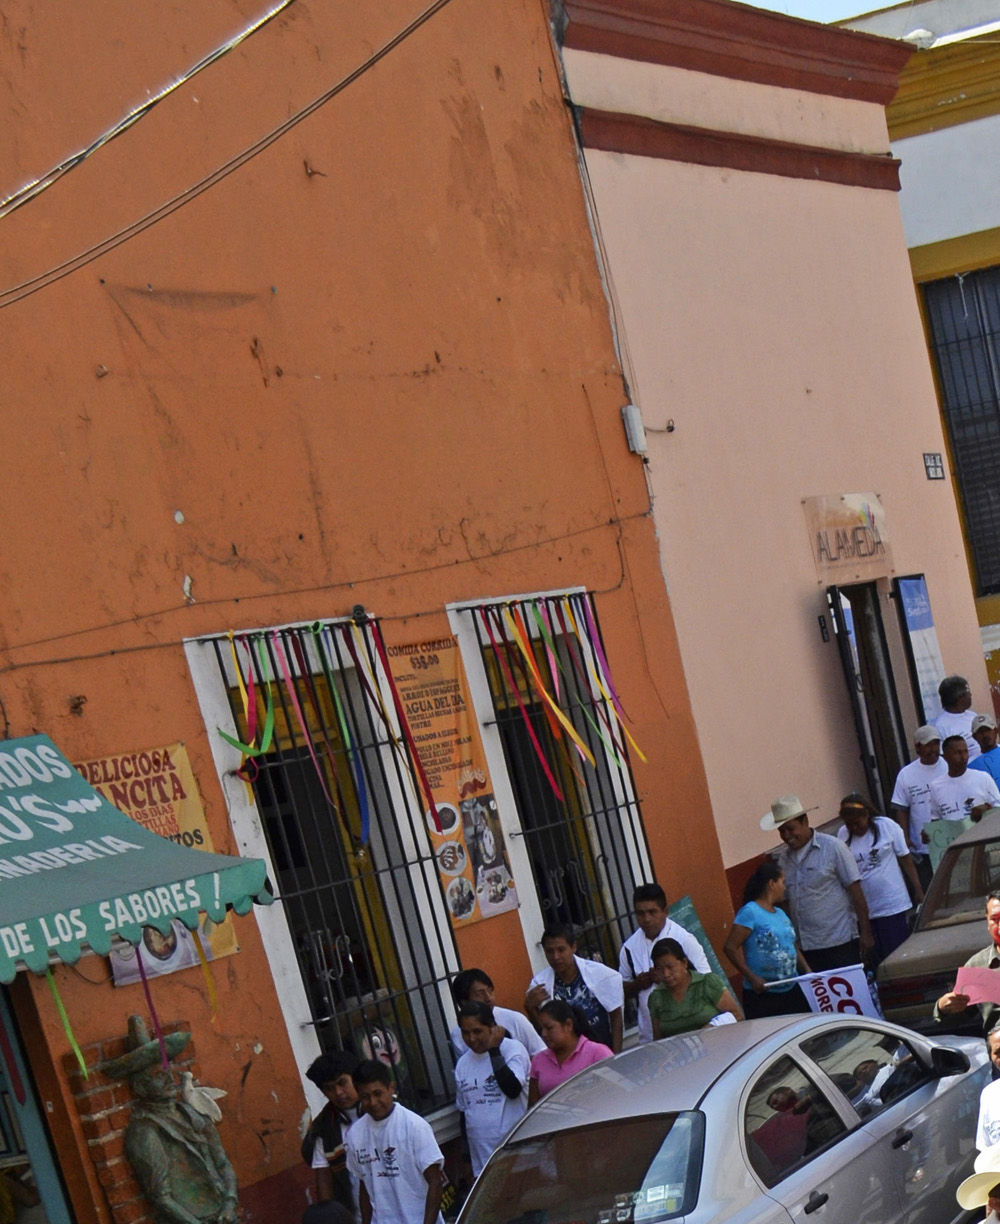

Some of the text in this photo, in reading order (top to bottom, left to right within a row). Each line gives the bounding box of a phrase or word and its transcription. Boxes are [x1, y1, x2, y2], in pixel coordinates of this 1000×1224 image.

[816, 526, 886, 562] ALAMEDA
[387, 638, 458, 657] COMIDA CORRIDA
[405, 700, 433, 716] AGUA
[433, 696, 451, 710] DEL
[73, 748, 177, 785] DELICIOSA
[1, 922, 35, 958] DE
[39, 908, 88, 947] LOS
[99, 880, 201, 931] SABORES
